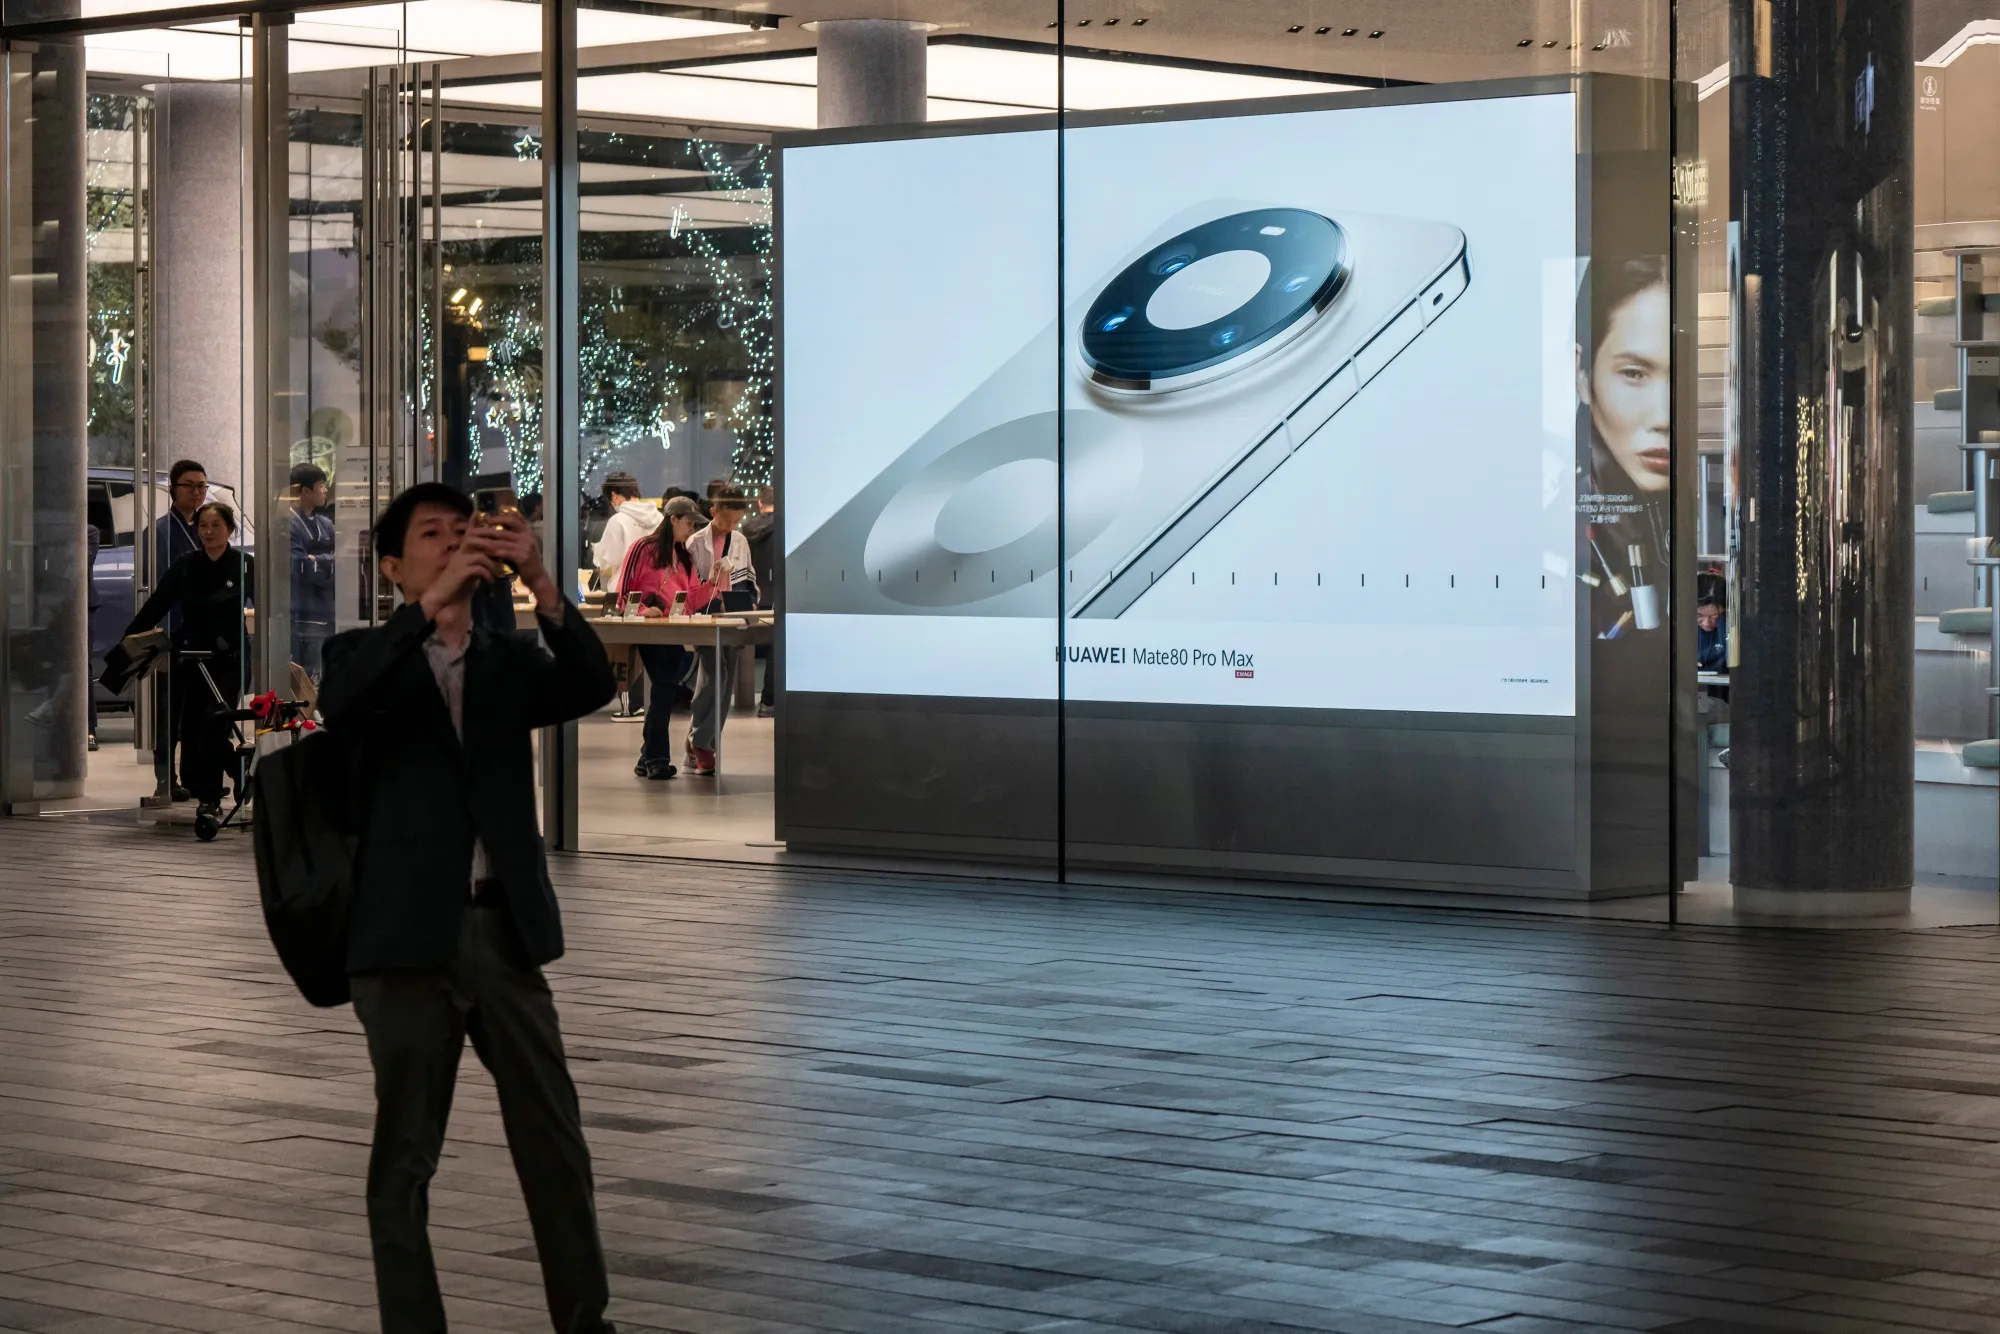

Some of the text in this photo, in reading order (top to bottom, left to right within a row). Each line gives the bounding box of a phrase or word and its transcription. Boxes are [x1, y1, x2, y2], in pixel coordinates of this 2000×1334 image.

[1133, 648, 1188, 665] Mate80
[1193, 649, 1217, 667] Pro
[1221, 649, 1254, 668] Max
